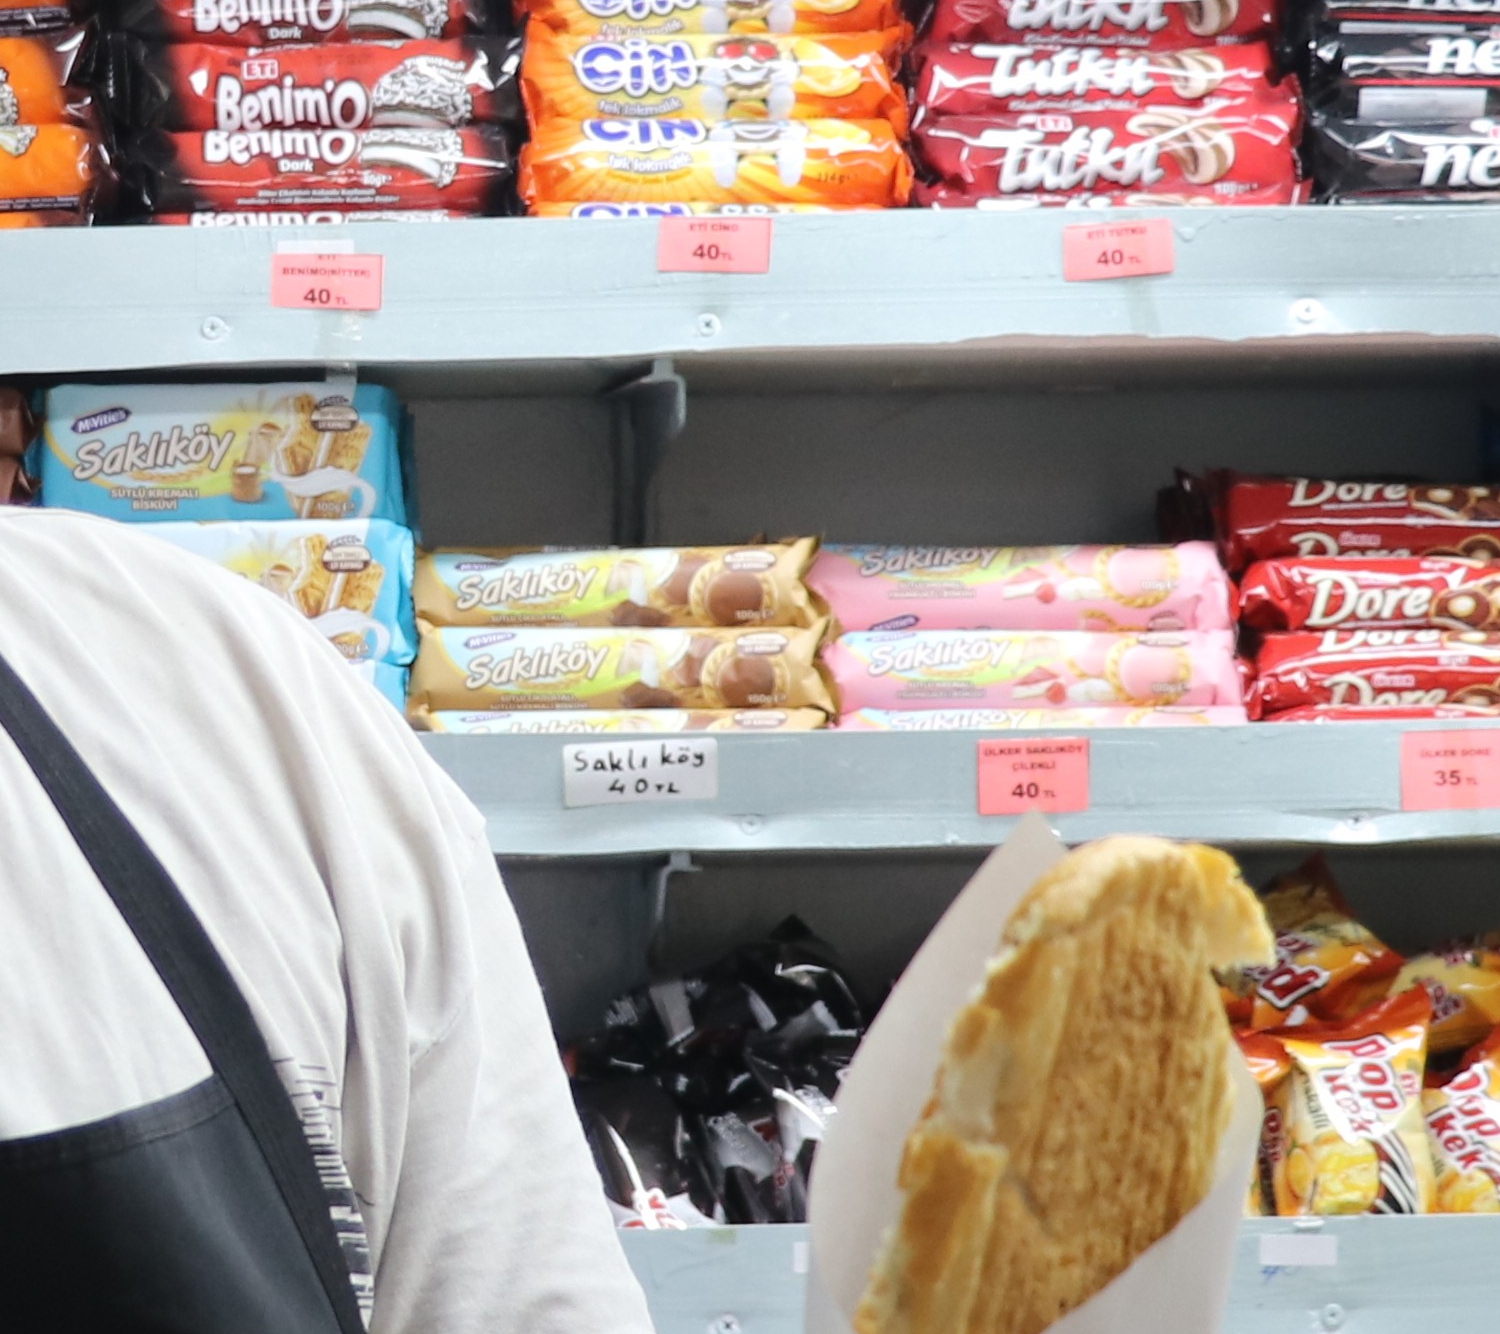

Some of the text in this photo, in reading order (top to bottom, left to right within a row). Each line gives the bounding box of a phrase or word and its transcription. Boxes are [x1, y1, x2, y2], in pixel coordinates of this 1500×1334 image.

[269, 27, 301, 40] Dark
[972, 45, 1154, 97] Tutku
[279, 160, 313, 172] Dark
[979, 127, 1164, 192] Tutku
[693, 245, 719, 260] 40
[1097, 250, 1142, 265] 40 TL
[304, 288, 331, 304] 40
[73, 424, 234, 480] Saklıköy
[111, 488, 198, 498] SÜTLÜ KREMALI
[133, 499, 177, 510] BİSKÜVİ
[457, 564, 597, 609] Saklıköy
[1305, 572, 1433, 627] Dore
[466, 643, 608, 690] Saklıköy
[575, 744, 705, 772] Saklı köy
[1435, 770, 1461, 786] 35
[1012, 783, 1055, 798] 40 TL
